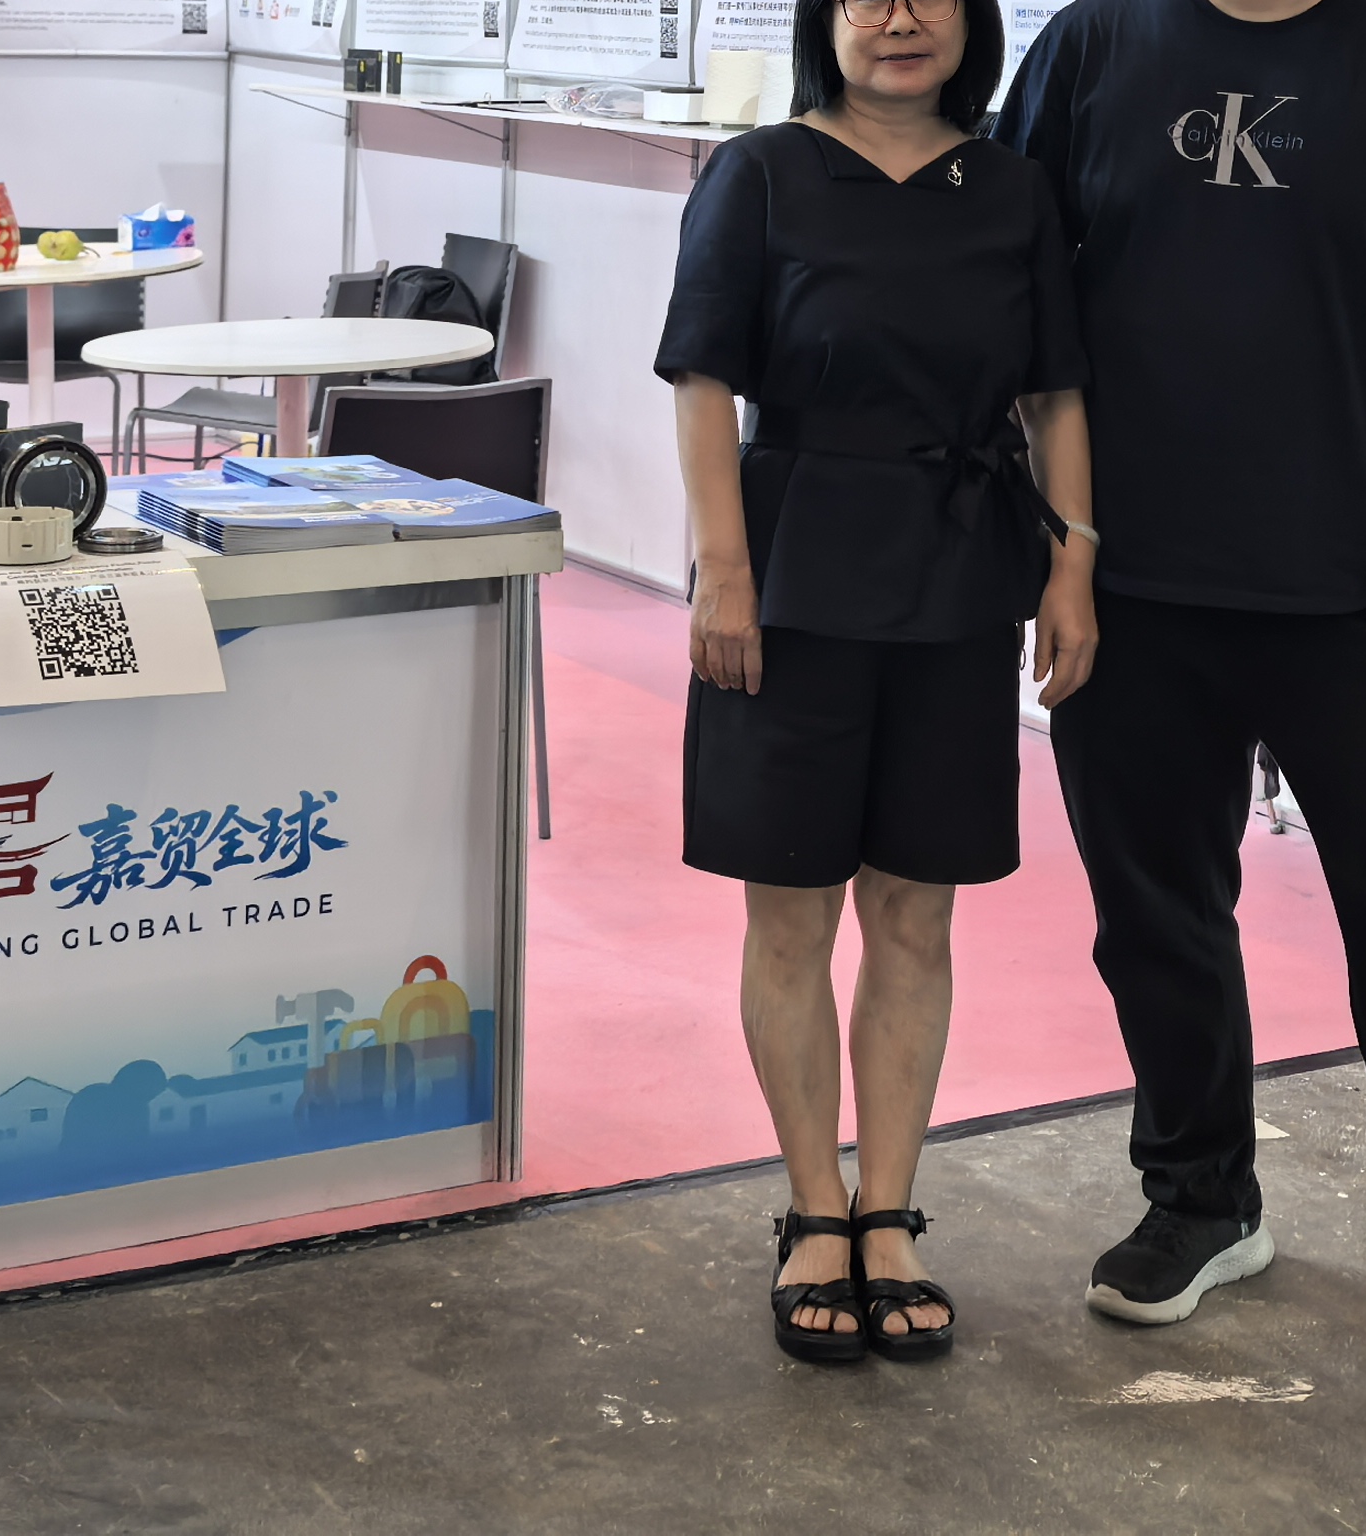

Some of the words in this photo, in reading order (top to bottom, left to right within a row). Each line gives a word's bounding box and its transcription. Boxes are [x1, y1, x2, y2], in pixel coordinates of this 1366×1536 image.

[1251, 131, 1304, 150] Klein
[50, 790, 350, 910] 嘉贸全球
[61, 912, 203, 950] GLOBAL
[222, 893, 333, 927] TRADE
